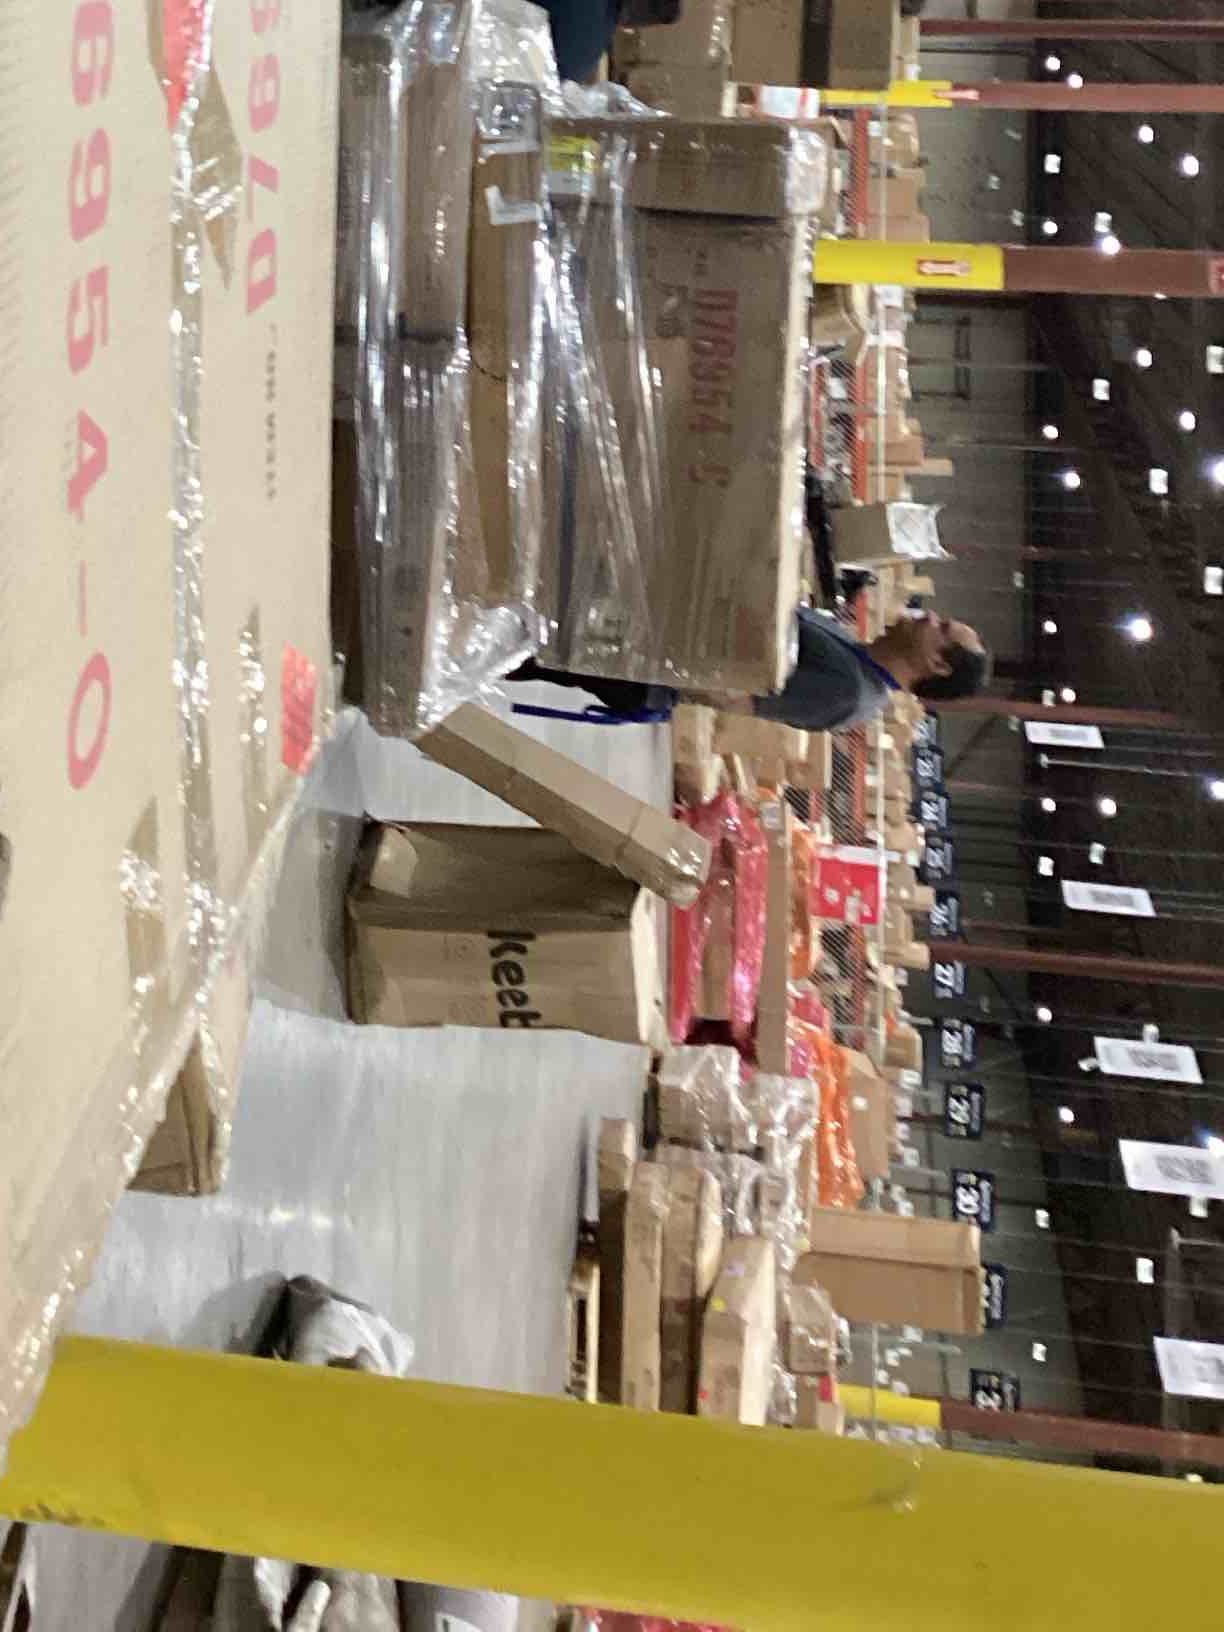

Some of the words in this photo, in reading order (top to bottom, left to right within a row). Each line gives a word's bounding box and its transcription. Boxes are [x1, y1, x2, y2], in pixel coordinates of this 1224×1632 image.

[934, 963, 955, 988] 27
[948, 1096, 971, 1124] 29
[955, 1186, 981, 1215] 30
